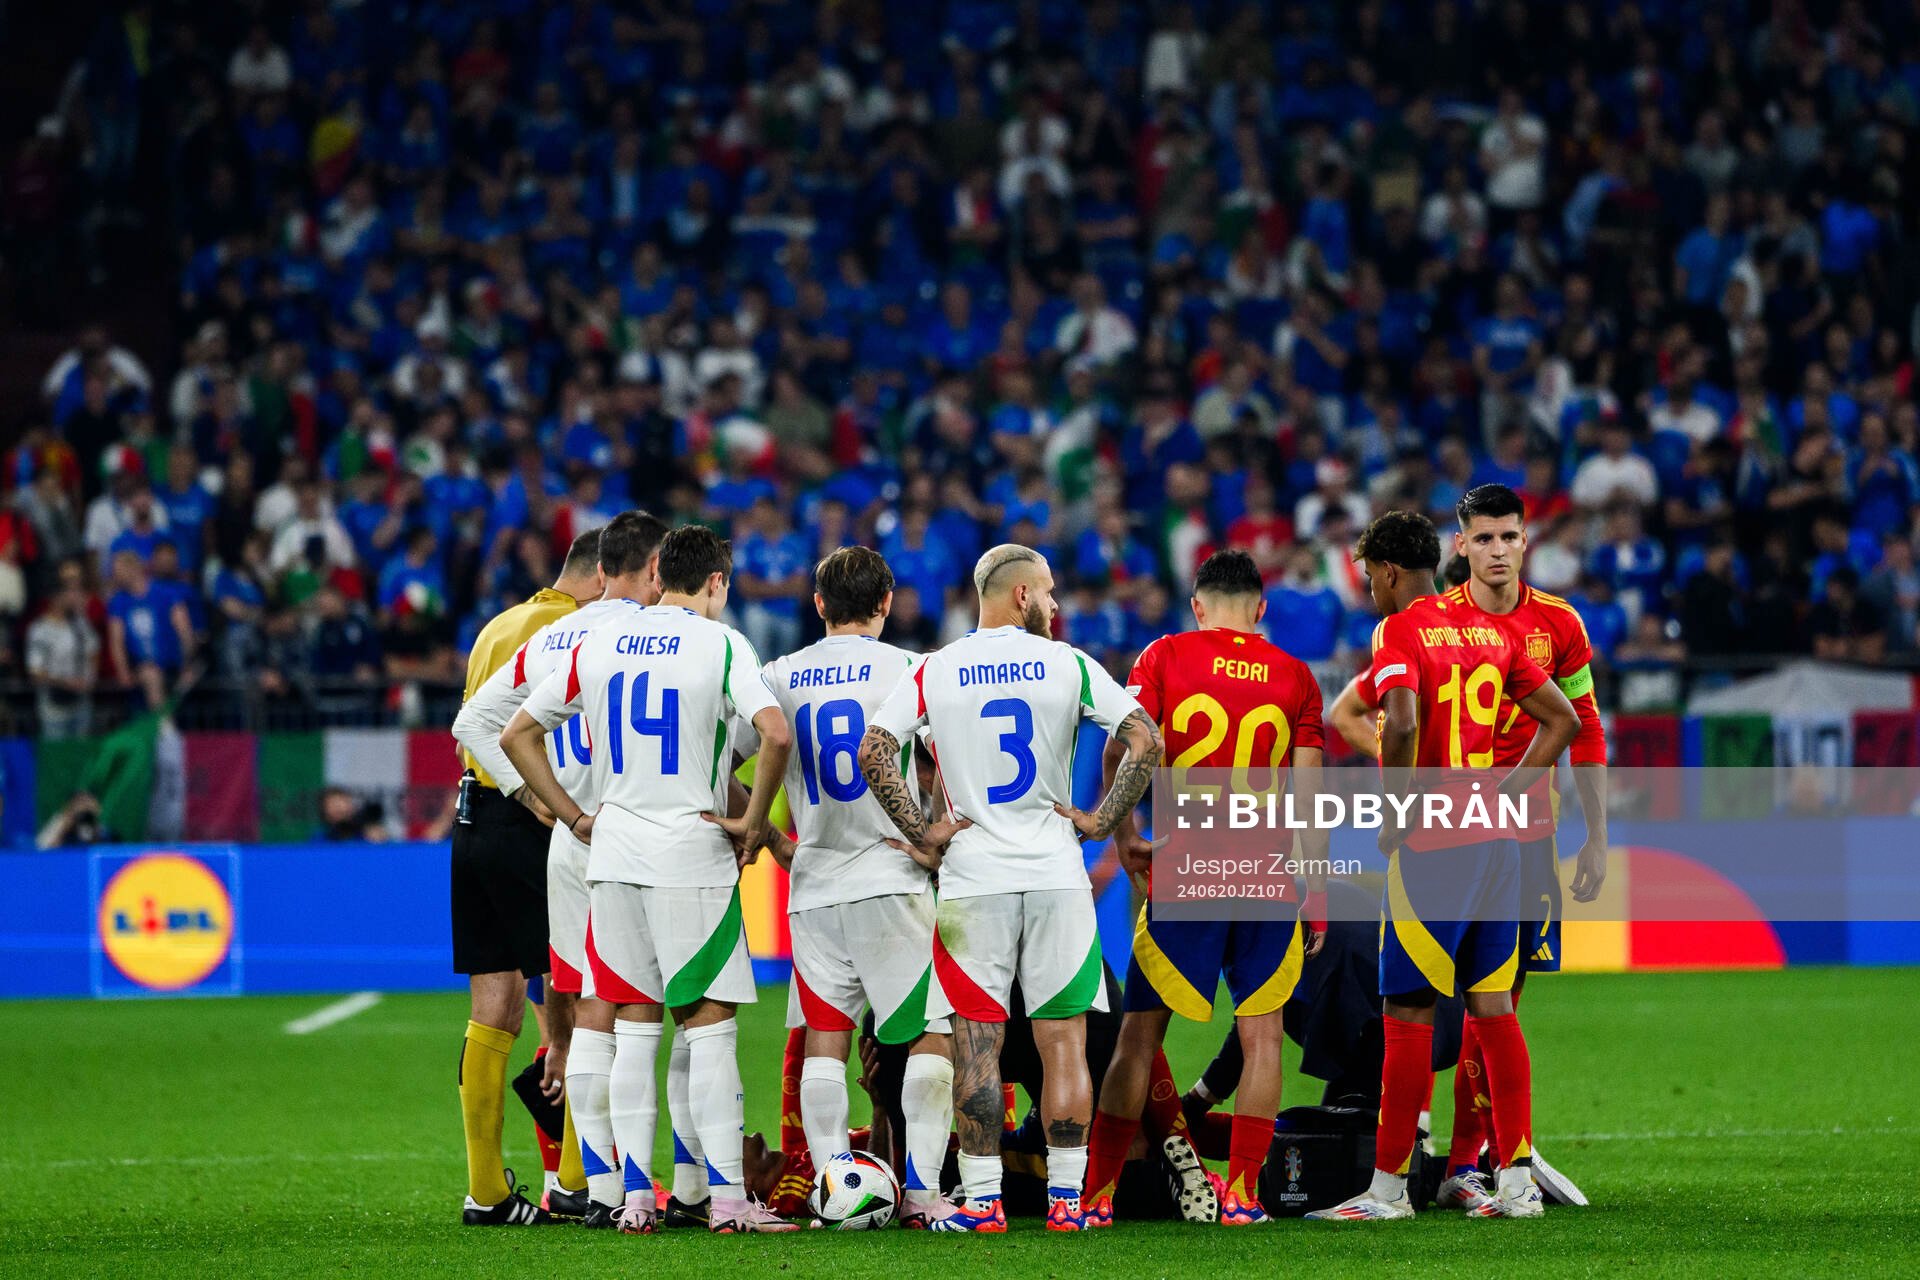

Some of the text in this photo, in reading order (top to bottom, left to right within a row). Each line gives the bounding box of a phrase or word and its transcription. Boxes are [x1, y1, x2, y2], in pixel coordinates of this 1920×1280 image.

[616, 635, 681, 656] CHIESA
[1212, 656, 1269, 683] PEDRI
[1418, 627, 1464, 647] LAMINE
[789, 664, 872, 690] BARELLA
[959, 661, 1046, 687] DIMARCO
[608, 670, 679, 775] 14
[1438, 663, 1503, 770] 19
[795, 698, 869, 806] 18
[980, 697, 1037, 804] 3
[1172, 692, 1291, 809] 20
